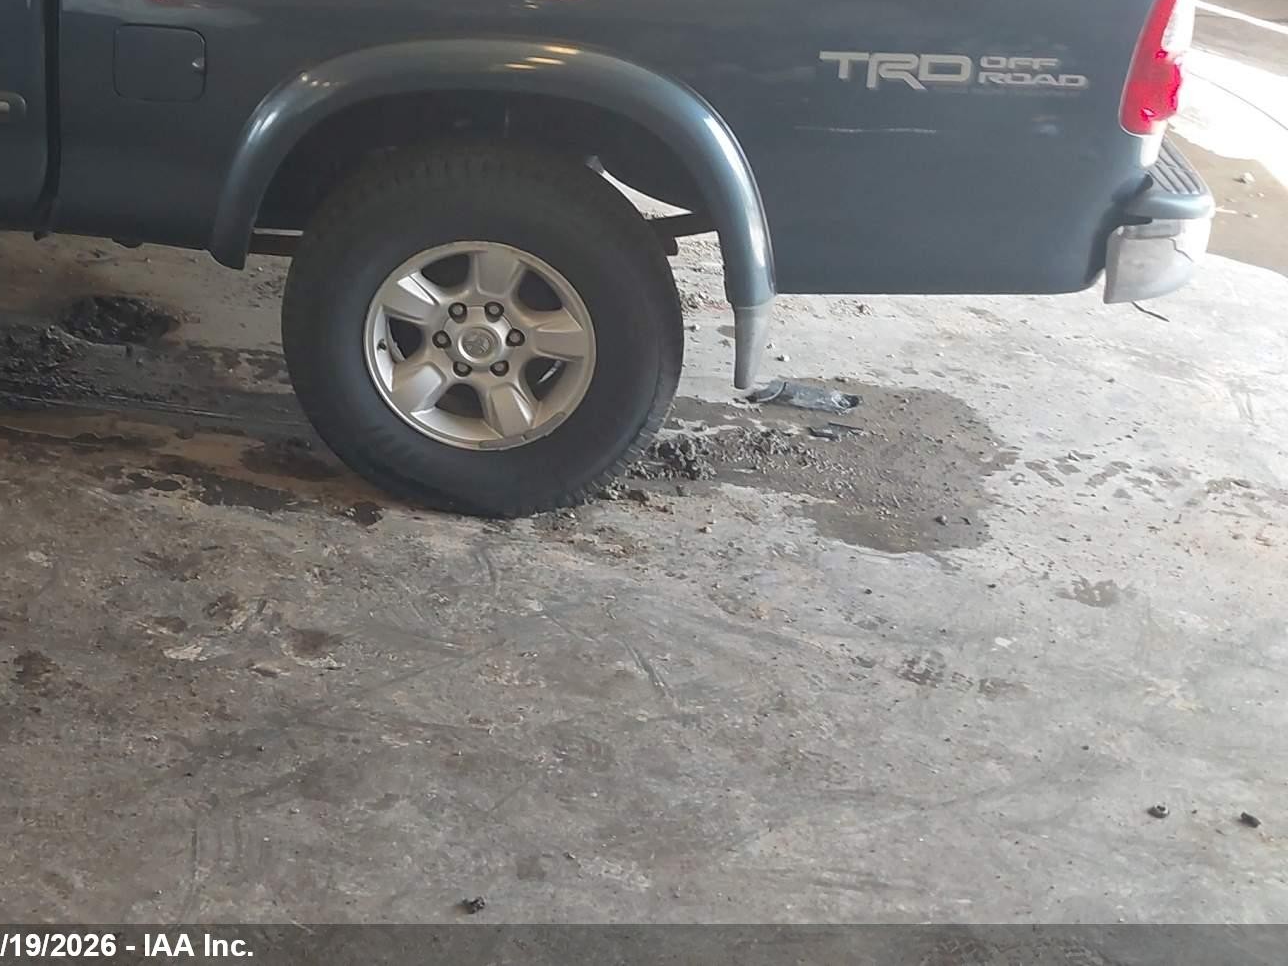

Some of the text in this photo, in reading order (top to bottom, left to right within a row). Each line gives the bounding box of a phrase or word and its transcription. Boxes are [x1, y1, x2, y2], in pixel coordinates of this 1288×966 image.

[819, 51, 973, 91] TRD
[979, 56, 1059, 70] OFF
[977, 71, 1089, 89] ROAD
